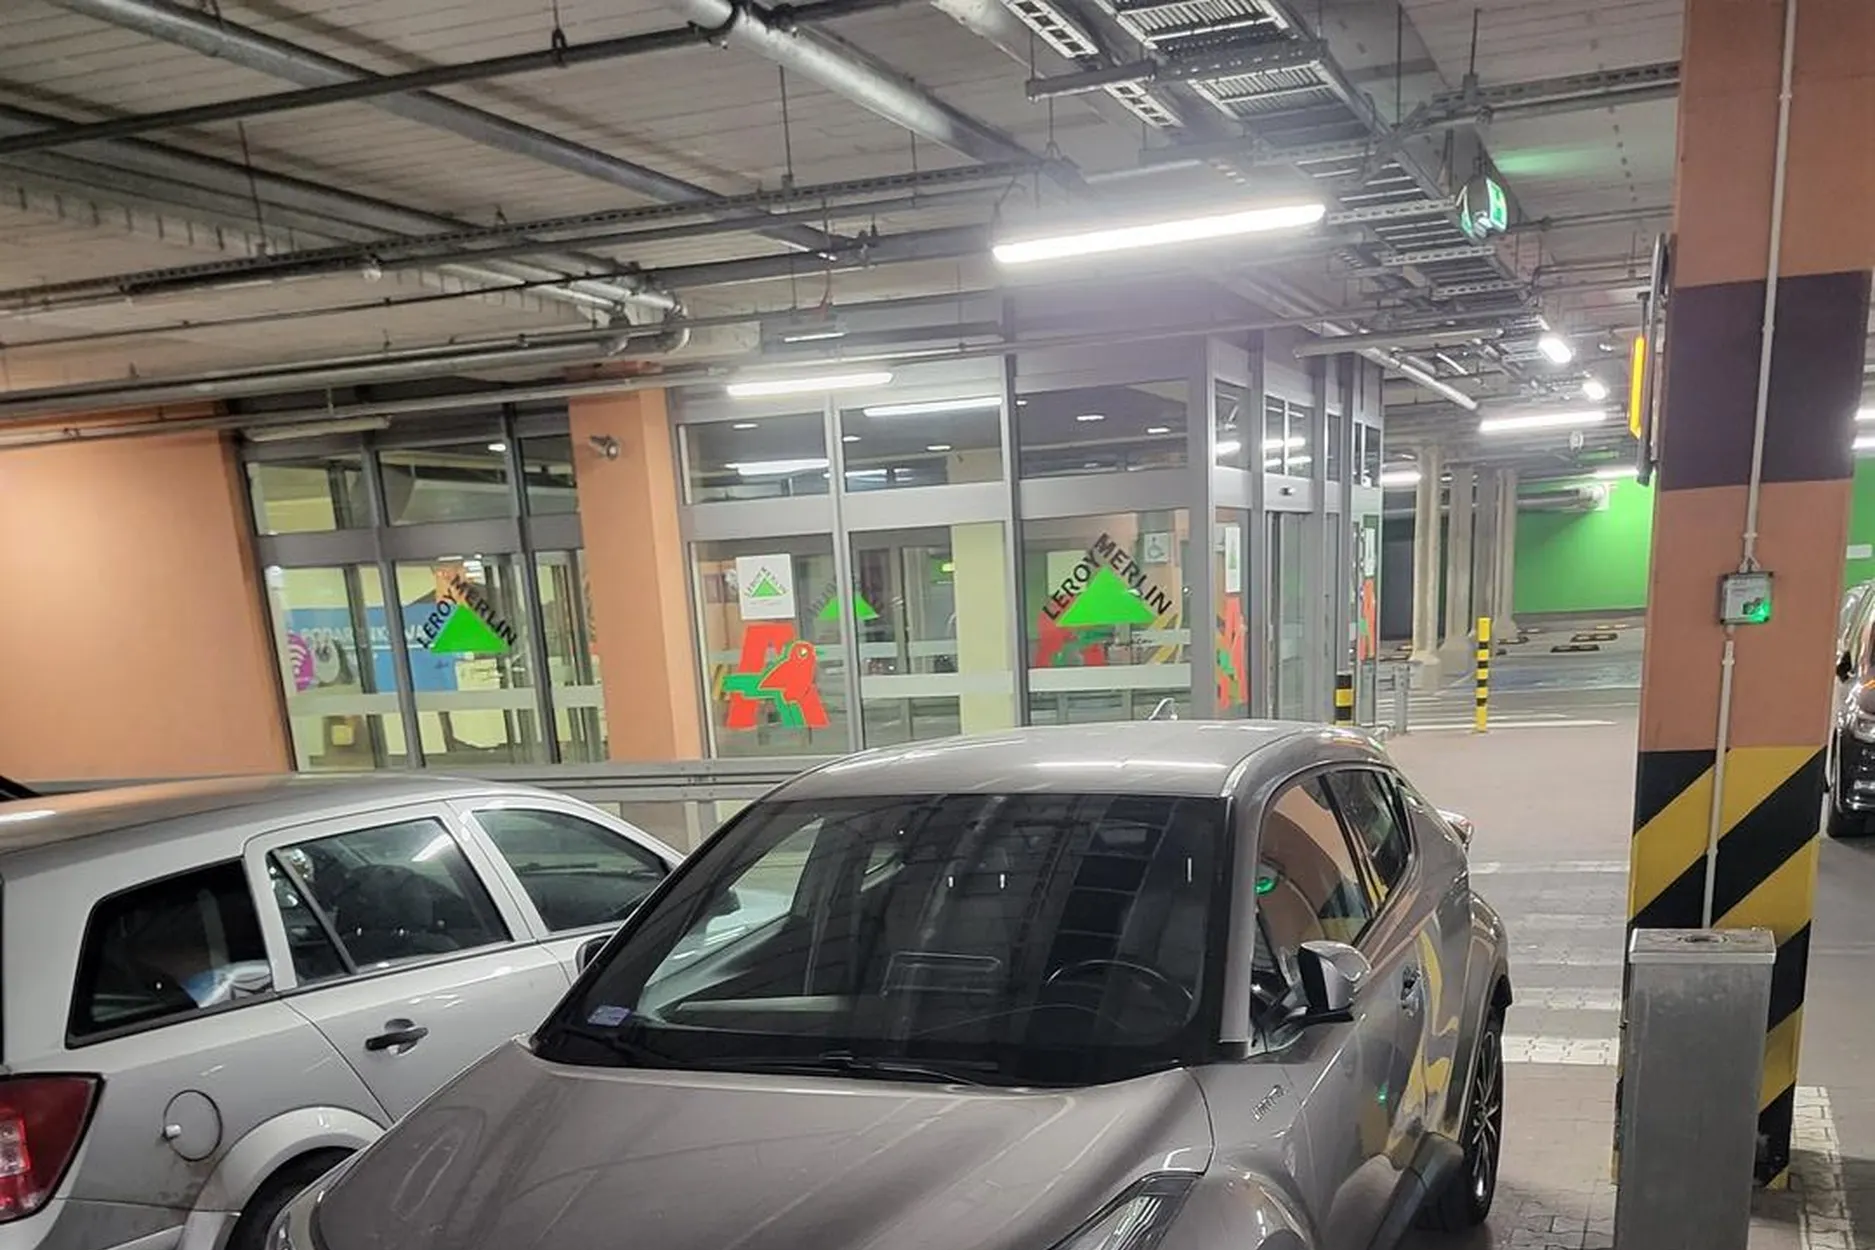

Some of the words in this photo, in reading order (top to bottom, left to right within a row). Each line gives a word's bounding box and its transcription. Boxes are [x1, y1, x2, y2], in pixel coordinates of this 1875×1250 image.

[416, 588, 459, 649] LEROY
[451, 573, 518, 647] MERLIN
[1042, 550, 1100, 620] LEROY
[1094, 533, 1172, 615] MERLIN
